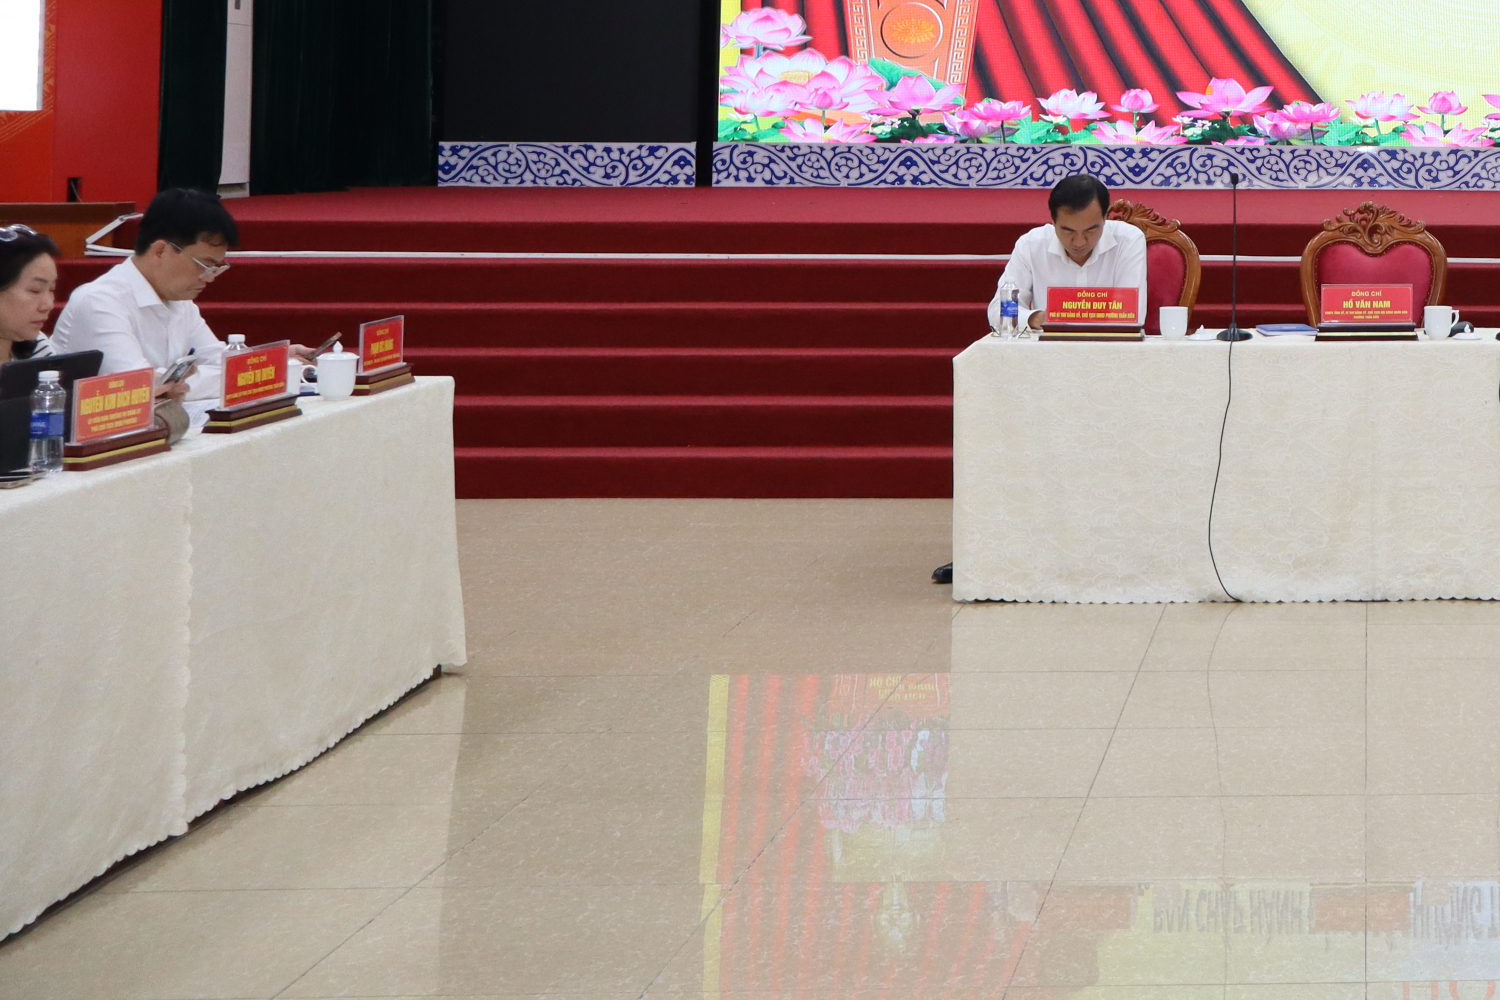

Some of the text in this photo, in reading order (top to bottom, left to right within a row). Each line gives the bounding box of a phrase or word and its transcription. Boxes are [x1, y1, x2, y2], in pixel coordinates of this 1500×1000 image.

[1092, 301, 1106, 310] DUY
[1355, 299, 1371, 308] VĂN
[1373, 300, 1391, 308] NAM
